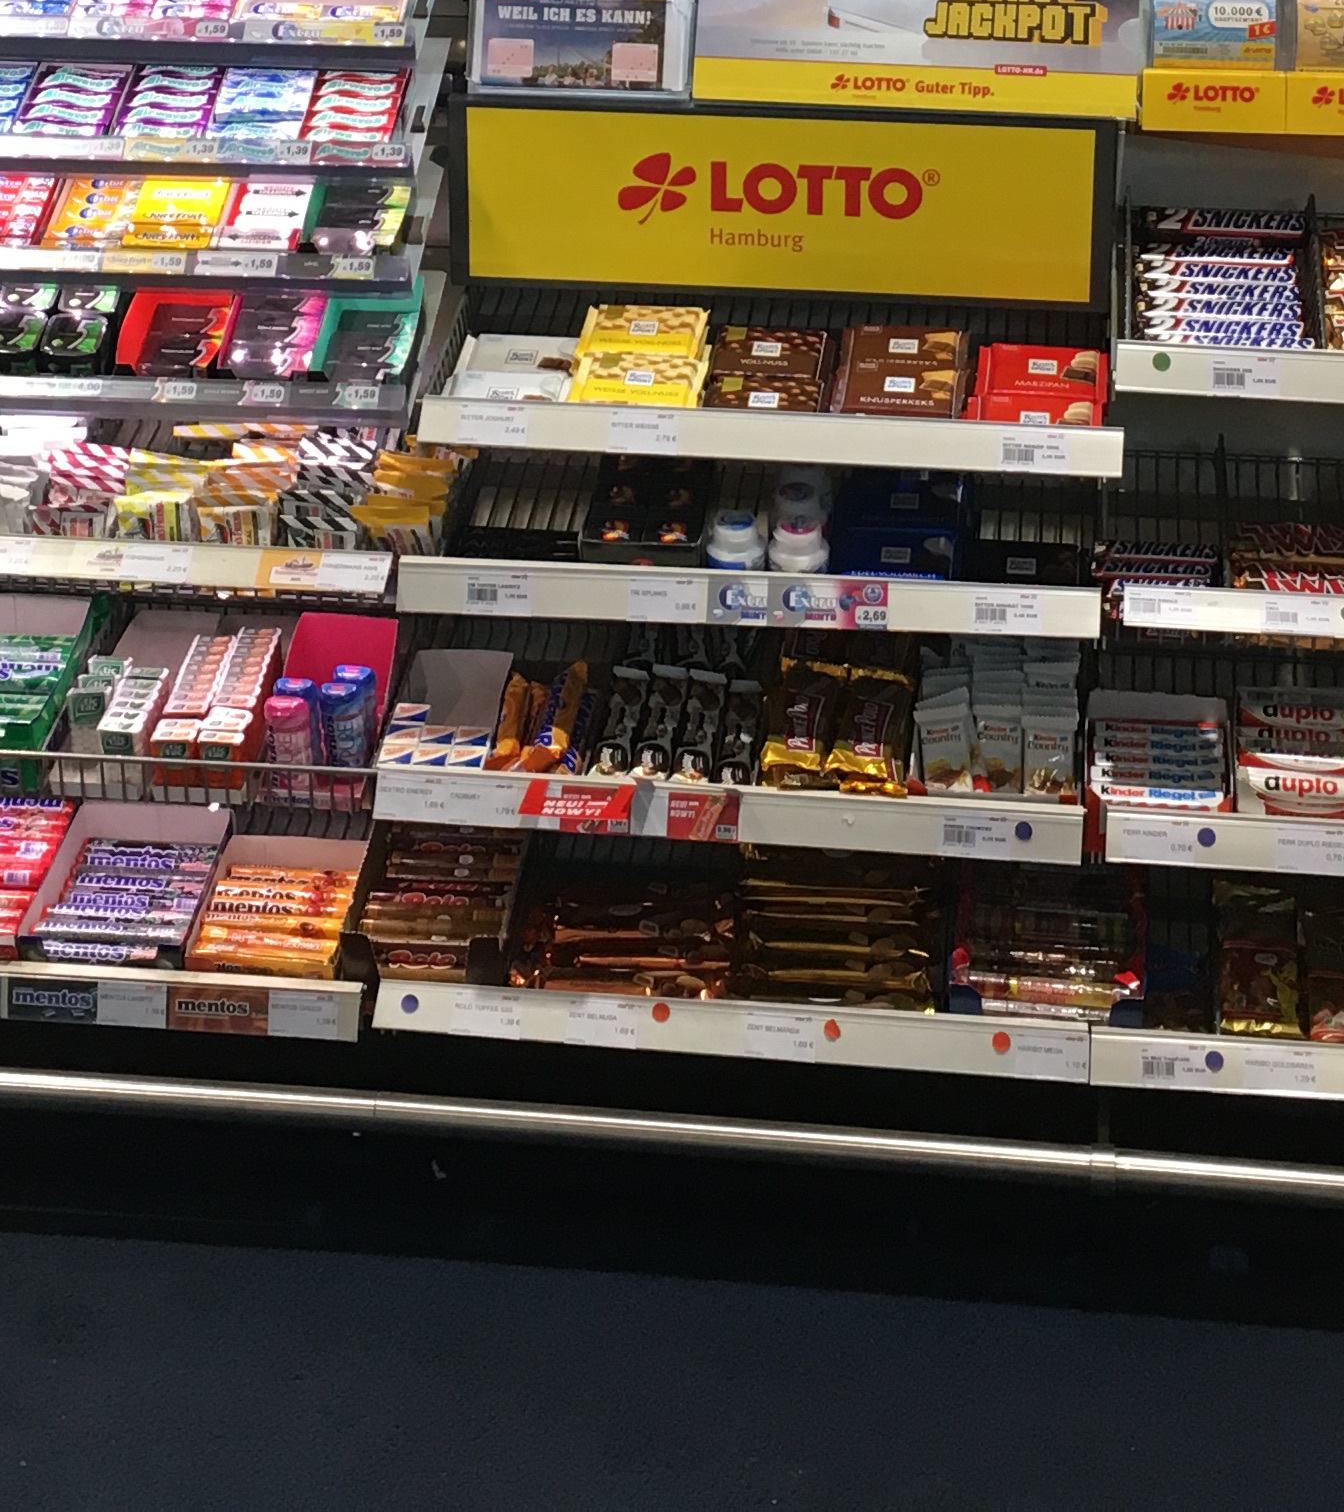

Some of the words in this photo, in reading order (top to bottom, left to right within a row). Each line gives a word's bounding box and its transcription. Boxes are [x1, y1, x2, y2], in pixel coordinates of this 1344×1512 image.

[497, 5, 538, 21] WEIL
[543, 7, 570, 21] ICH
[575, 8, 596, 23] ES
[601, 8, 653, 25] KANN!
[925, 0, 1097, 43] JACKPOT
[914, 81, 956, 97] Guter
[959, 82, 995, 99] Tipp.
[1193, 84, 1255, 103] LOTTO
[1193, 211, 1306, 232] SNICKERS
[709, 228, 804, 252] Hamburg
[1182, 265, 1296, 283] SNICKERS
[1151, 789, 1196, 801] Riegel
[1264, 774, 1339, 796] duplo
[176, 998, 249, 1018] mentos
